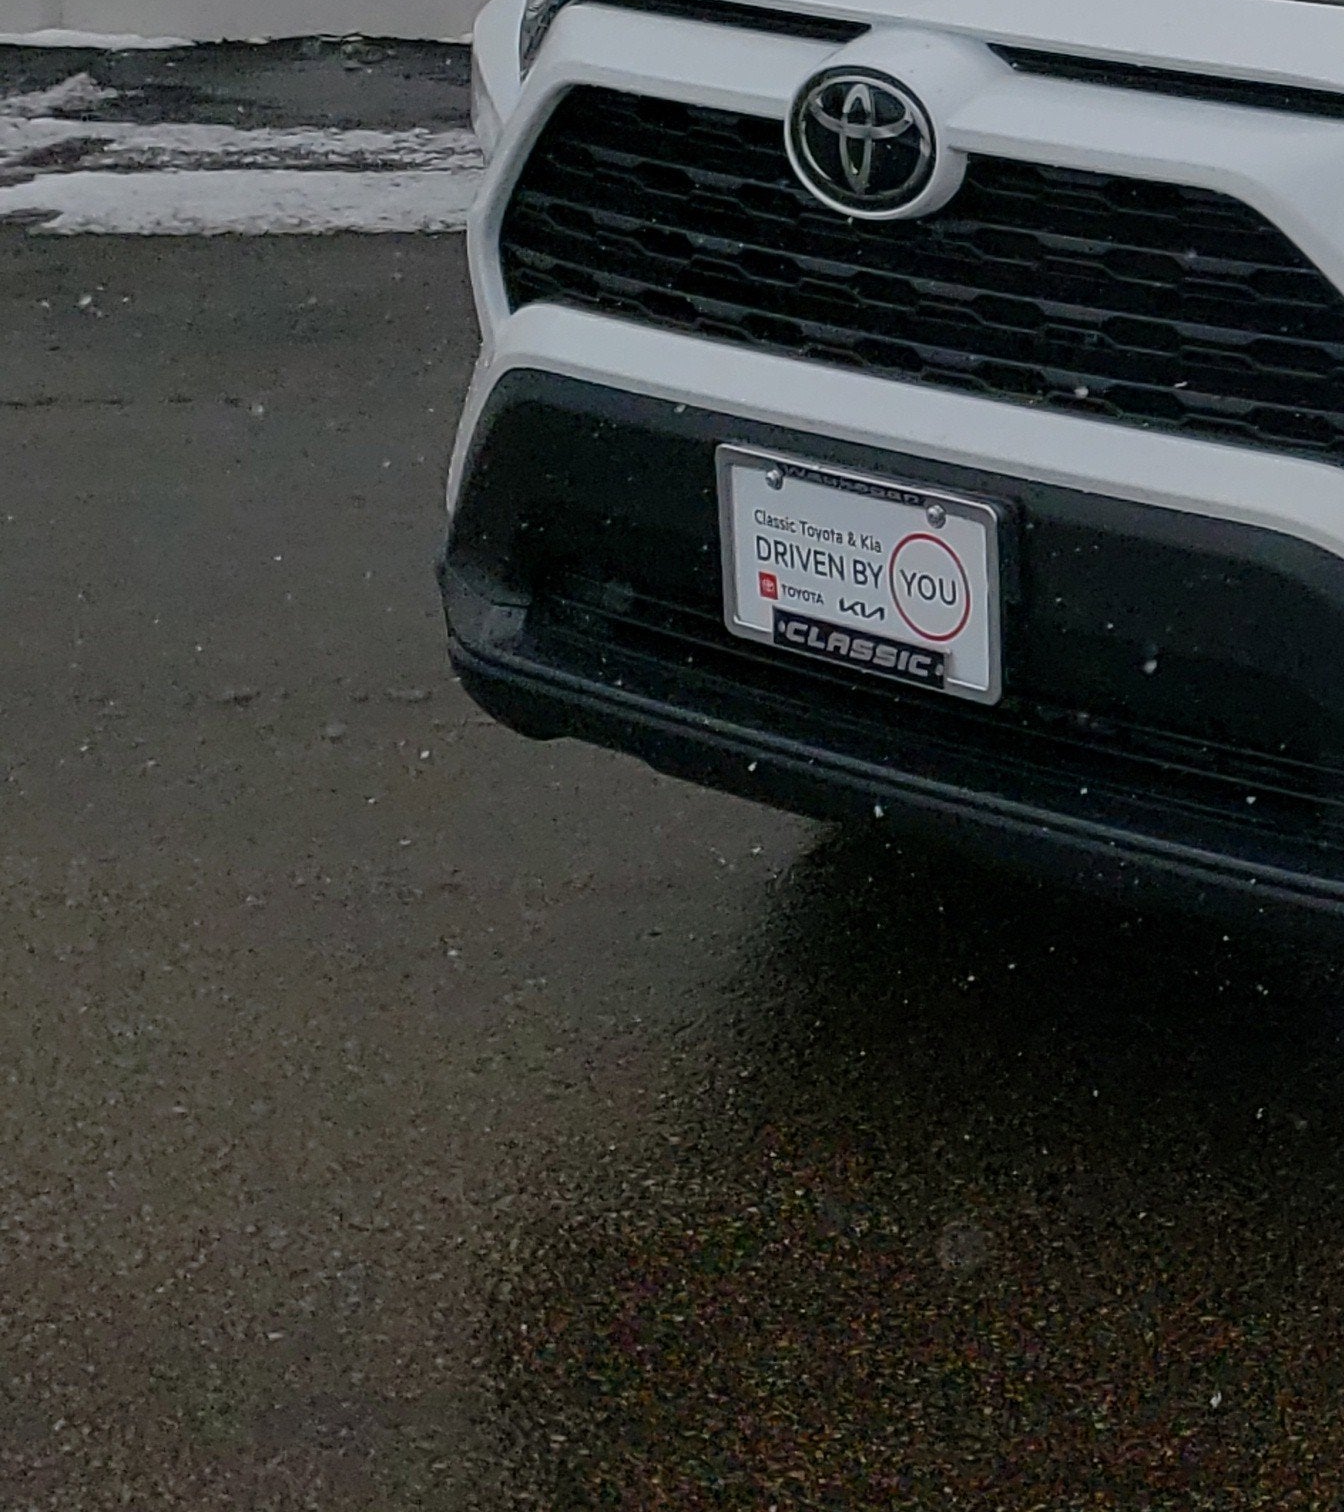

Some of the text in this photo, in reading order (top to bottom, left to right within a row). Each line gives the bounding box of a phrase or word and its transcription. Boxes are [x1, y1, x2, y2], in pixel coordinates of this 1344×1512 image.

[754, 509, 883, 554] Classic Toyota & Kia
[755, 535, 958, 607] DRIVEN BY YOU
[781, 583, 825, 606] TOYOTA
[784, 620, 933, 678] CLASSIC
